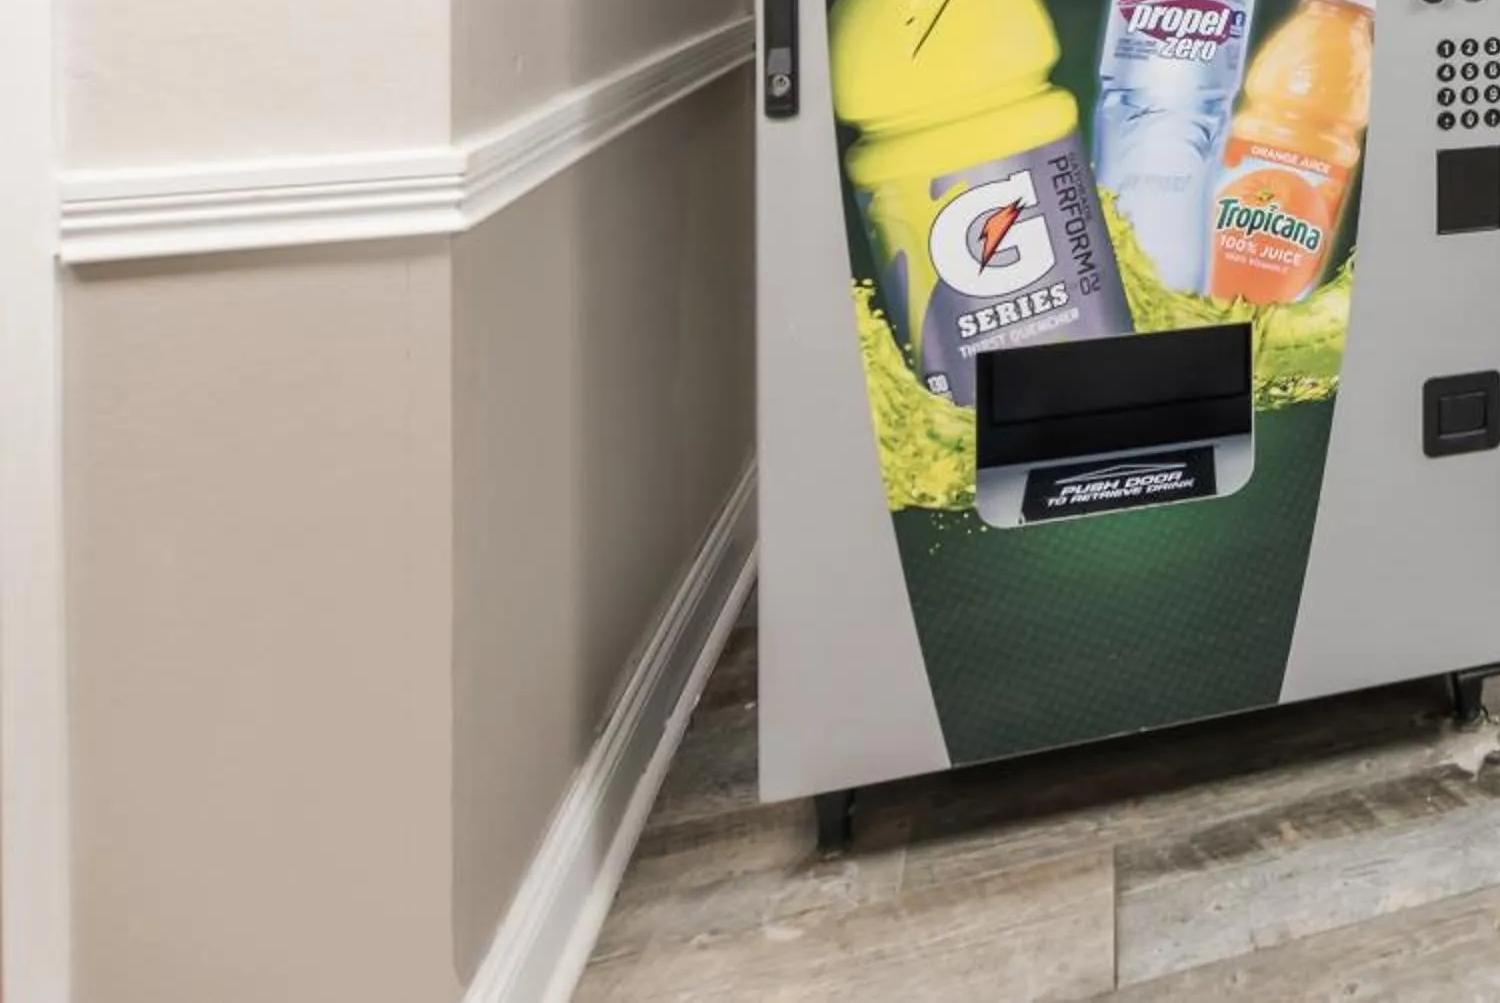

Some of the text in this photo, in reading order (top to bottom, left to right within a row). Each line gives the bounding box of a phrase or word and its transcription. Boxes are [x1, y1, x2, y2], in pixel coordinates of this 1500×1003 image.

[1128, 3, 1229, 38] propel
[1159, 37, 1217, 61] zero
[1251, 146, 1332, 173] ORANGE JUICE
[928, 169, 1056, 296] G
[1048, 156, 1099, 281] PERFORM
[1215, 197, 1321, 251] Tropicana
[1220, 235, 1258, 254] 100%
[1260, 246, 1303, 266] JUICE
[957, 282, 1068, 338] SERIES
[960, 308, 1079, 358] THIRST QUENCHER
[1047, 478, 1195, 507] TO RETRIEVE DRINK
[1060, 470, 1182, 496] PUSH DOOR
